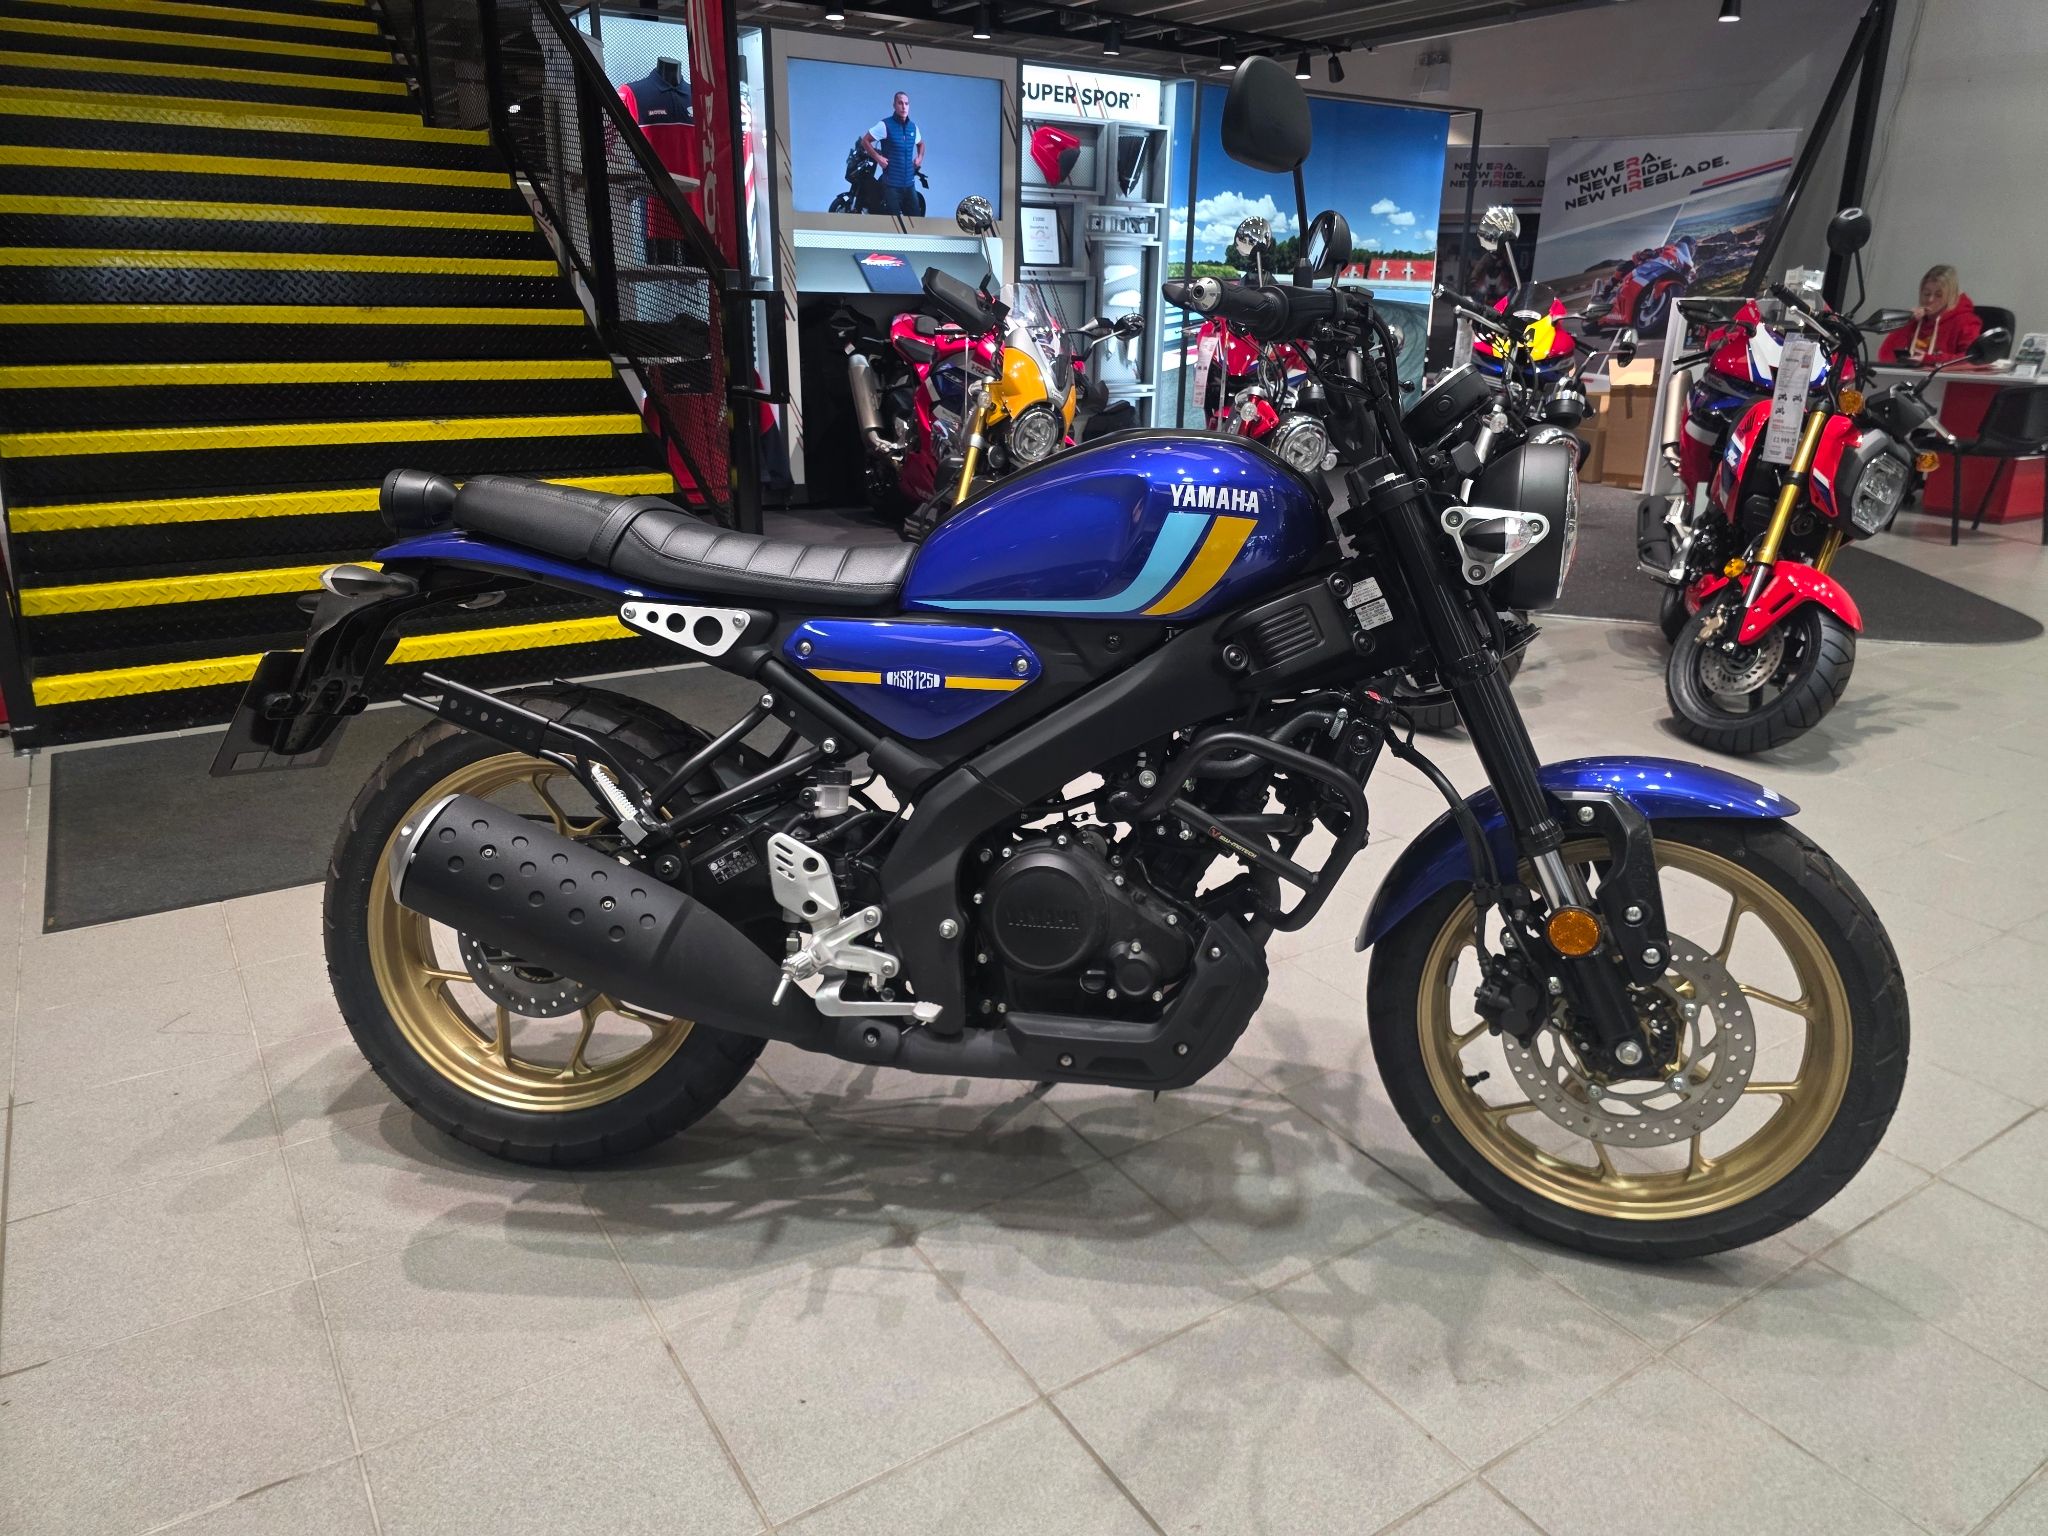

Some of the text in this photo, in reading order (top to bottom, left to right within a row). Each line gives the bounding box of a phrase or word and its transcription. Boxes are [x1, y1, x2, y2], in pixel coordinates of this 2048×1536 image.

[1081, 88, 1141, 109] SPOR
[1461, 171, 1526, 180] NW RIDE.
[1486, 162, 1518, 171] ERA.
[1566, 152, 1662, 187] NEW ERA.
[1579, 157, 1678, 195] NEW RIDE.
[1564, 155, 1730, 211] NEW FIREBLADE.
[1170, 484, 1260, 514] YAMAHA
[893, 670, 934, 690] XSR125
